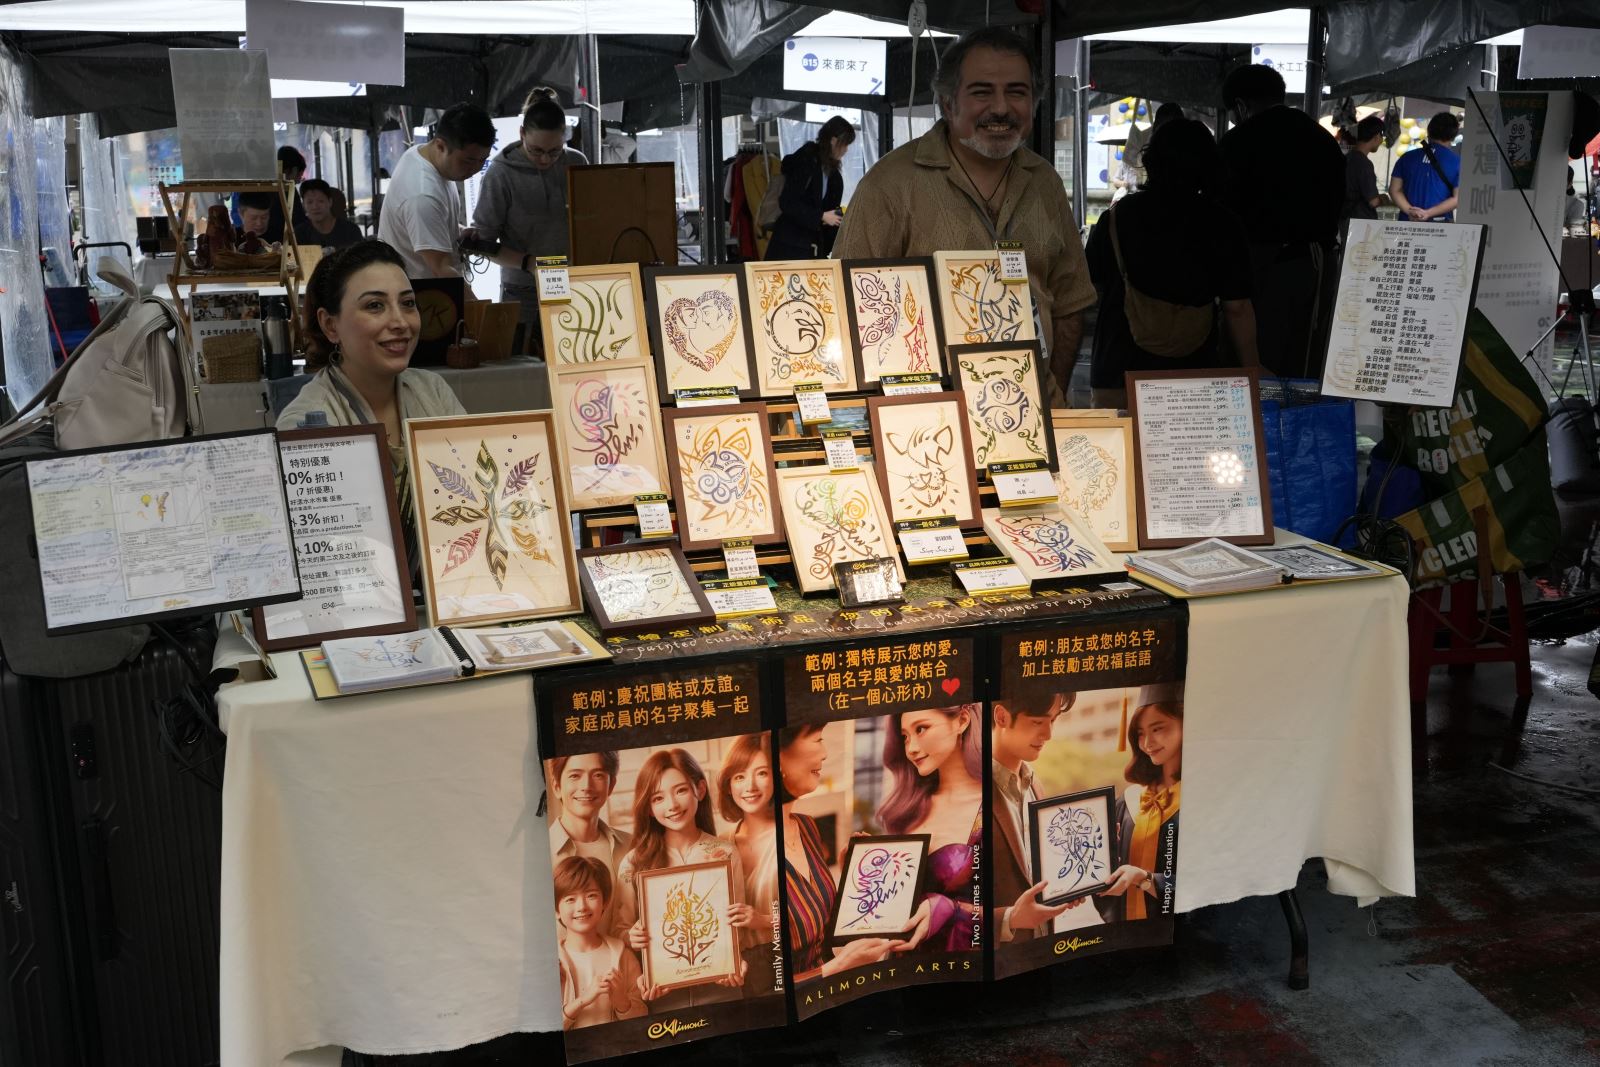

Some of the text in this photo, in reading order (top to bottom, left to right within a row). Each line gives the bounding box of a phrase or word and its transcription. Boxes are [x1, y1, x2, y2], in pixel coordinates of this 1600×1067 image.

[803, 58, 868, 71] B15 來都來了
[1277, 61, 1308, 72] 木工工
[1411, 263, 1438, 271] 如意吉祥
[1373, 305, 1399, 313] 希望之光
[1401, 317, 1428, 325] 愛你一生
[1381, 335, 1394, 343] 偉大
[1397, 339, 1431, 348] 永遠在一起
[1373, 348, 1393, 356] 祝福你
[1396, 346, 1423, 355] 美麗動人
[1364, 362, 1390, 370] 畢業快樂
[1365, 355, 1392, 363] 生日快樂
[1355, 376, 1388, 385] 母親節快樂
[1356, 369, 1389, 378] 父親節快樂
[289, 455, 331, 469] 特別優惠
[298, 512, 321, 527] 3%
[304, 540, 334, 555] 10%
[998, 602, 1040, 618] names
[1045, 600, 1061, 608] or
[1067, 597, 1093, 609] any
[1098, 592, 1130, 603] word
[805, 638, 959, 672] 範例：獨特展示您的愛。
[1022, 650, 1152, 678] 加上鼓勵或祝福話語
[811, 663, 948, 693] 兩個名字與愛的結合
[572, 674, 741, 711] 範例：慶祝團結或友誼。
[565, 695, 749, 734] 家庭成員的名字聚集一起
[971, 844, 981, 870] Love
[1162, 823, 1175, 914] Happy Graduation
[971, 883, 981, 921] Names
[971, 924, 981, 948] Two
[769, 899, 785, 992] Family Members
[805, 960, 972, 1005] ALIMONT ARTS
